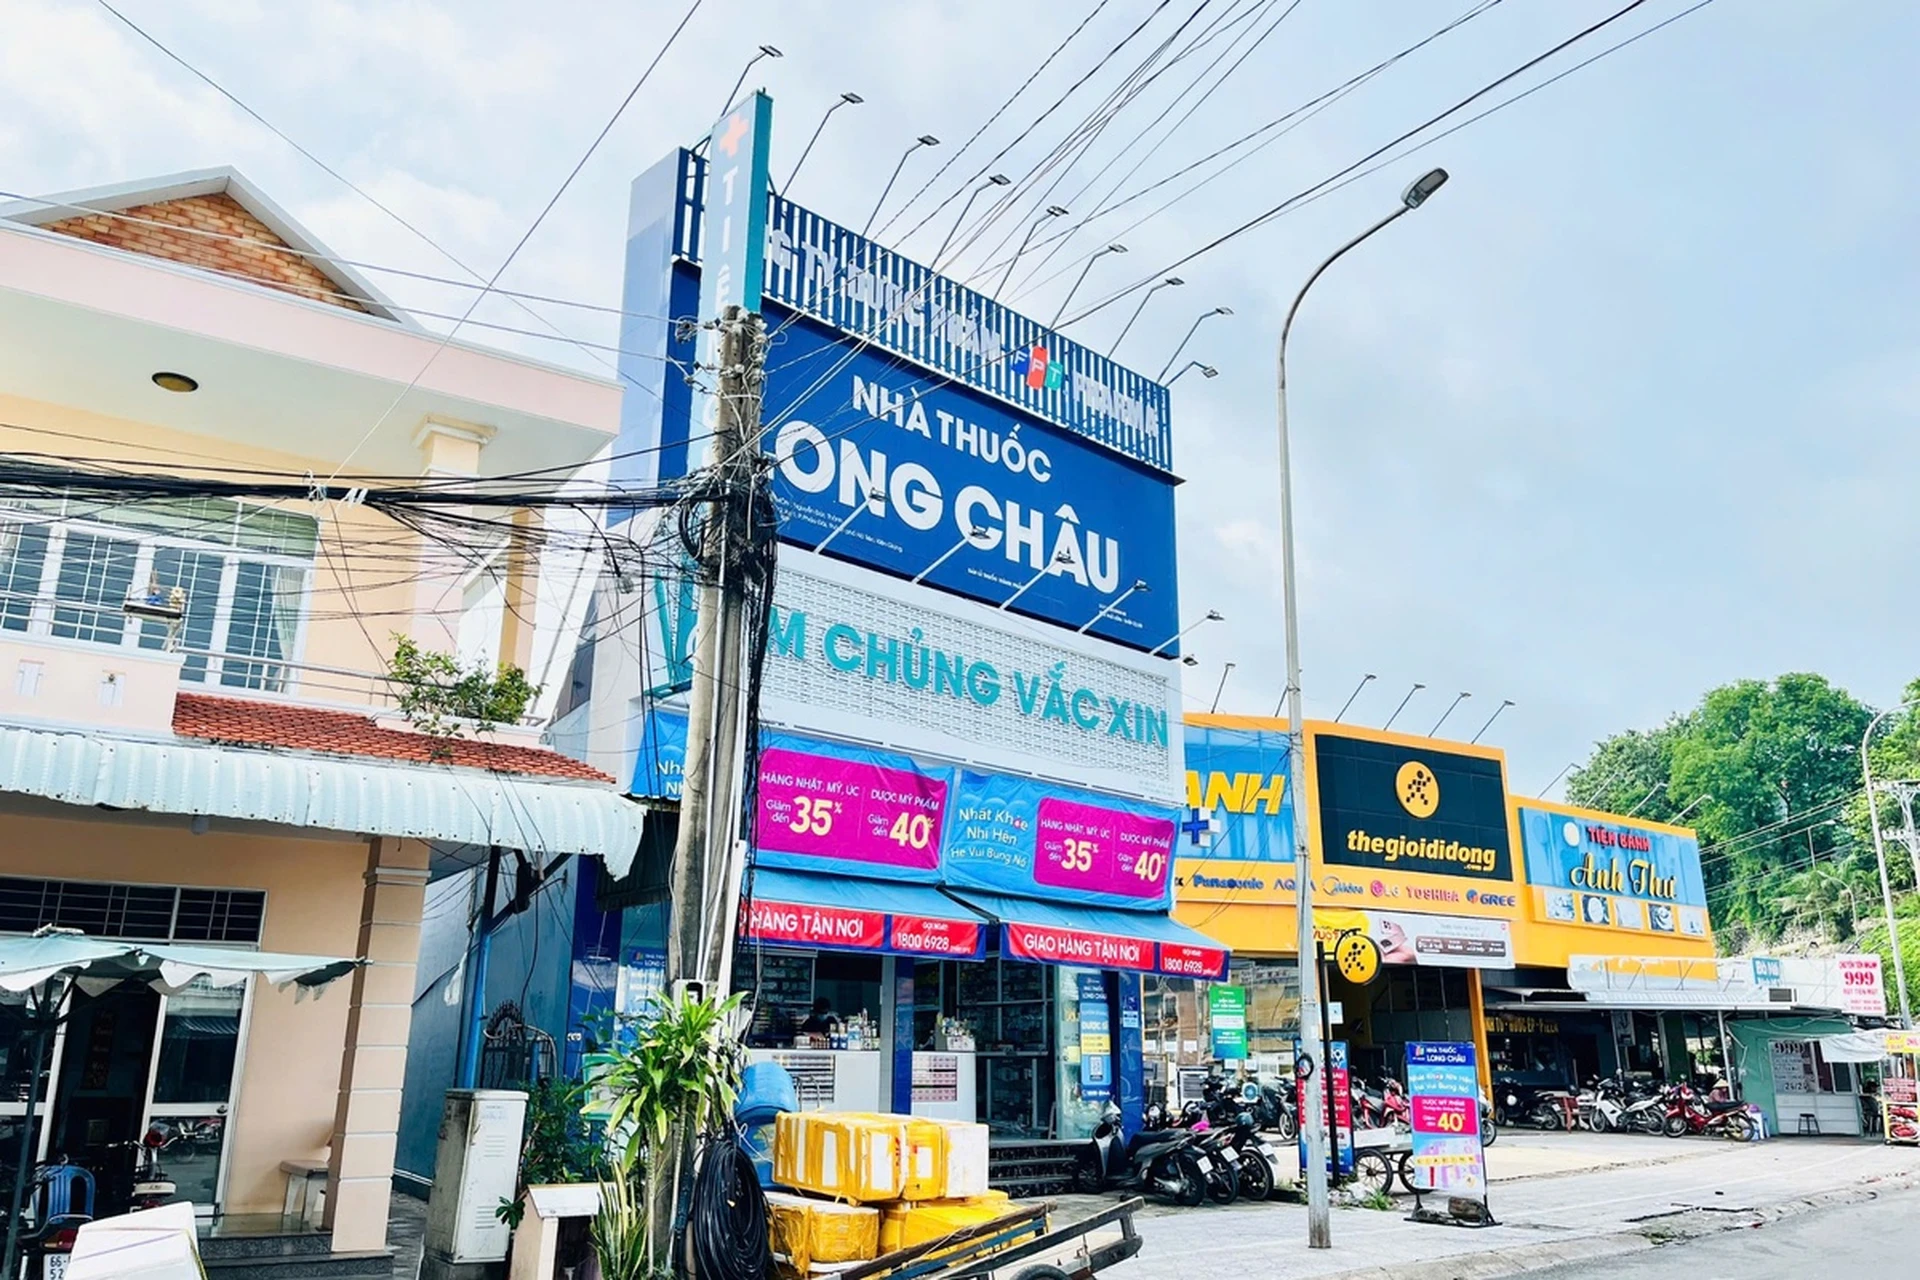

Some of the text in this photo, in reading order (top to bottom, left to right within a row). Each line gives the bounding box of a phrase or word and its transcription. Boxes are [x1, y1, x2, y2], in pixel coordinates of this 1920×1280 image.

[801, 240, 838, 289] TY
[1012, 347, 1063, 388] FPT
[853, 375, 1052, 482] NHÀ THUỐC
[954, 485, 1119, 594] CHÂU
[824, 624, 1001, 706] CHỦNG
[1012, 660, 1101, 732] VẮC
[1106, 694, 1169, 748] XIN
[761, 771, 793, 786] HÀNG
[795, 777, 825, 792] NHẬT,
[1347, 829, 1496, 872] thegioididong
[1193, 873, 1265, 890] Panasonic
[1570, 851, 1677, 900] Anh Thư
[1406, 886, 1460, 904] TOSHIBA
[1480, 894, 1516, 907] GREE
[751, 907, 798, 932] HÀNG
[802, 913, 834, 940] TẬN
[836, 918, 863, 938] NƠI
[897, 931, 922, 949] 1800
[924, 934, 950, 951] 6928
[1024, 933, 1057, 951] GIAO
[1059, 934, 1092, 957] HÀNG
[1094, 940, 1118, 964] TẬN
[1164, 957, 1182, 971] 1800
[1184, 960, 1203, 974] 6928
[1844, 971, 1875, 986] 999
[1426, 1054, 1446, 1063] LONG
[1447, 1053, 1467, 1063] CHÂU
